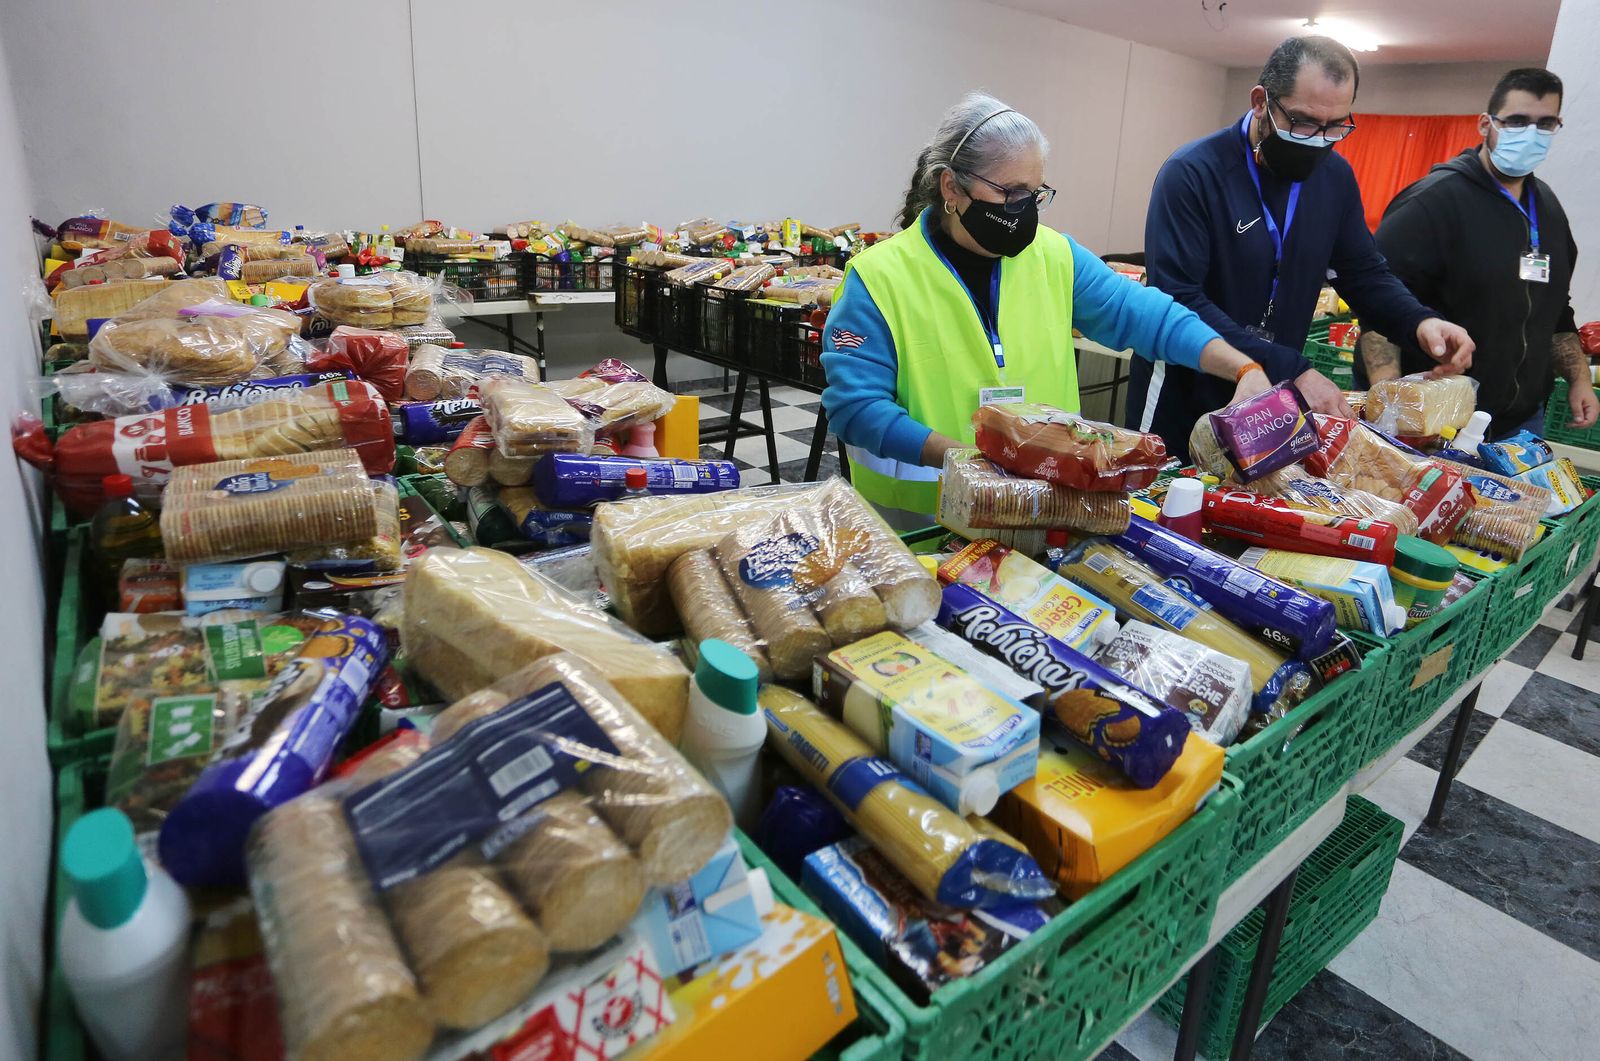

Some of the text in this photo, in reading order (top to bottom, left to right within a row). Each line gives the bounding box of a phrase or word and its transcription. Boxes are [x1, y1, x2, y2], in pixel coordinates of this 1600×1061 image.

[985, 211, 1011, 227] UNIDOS
[1238, 412, 1295, 446] BLANCO
[1245, 407, 1273, 427] PAN
[1290, 432, 1312, 450] gloria
[1319, 421, 1345, 455] BLANCO
[1436, 503, 1464, 535] BLANCO
[947, 538, 998, 580] 100% Natural
[1037, 595, 1082, 632] Casero
[1059, 612, 1081, 628] Caldo
[1262, 627, 1291, 646] 46%
